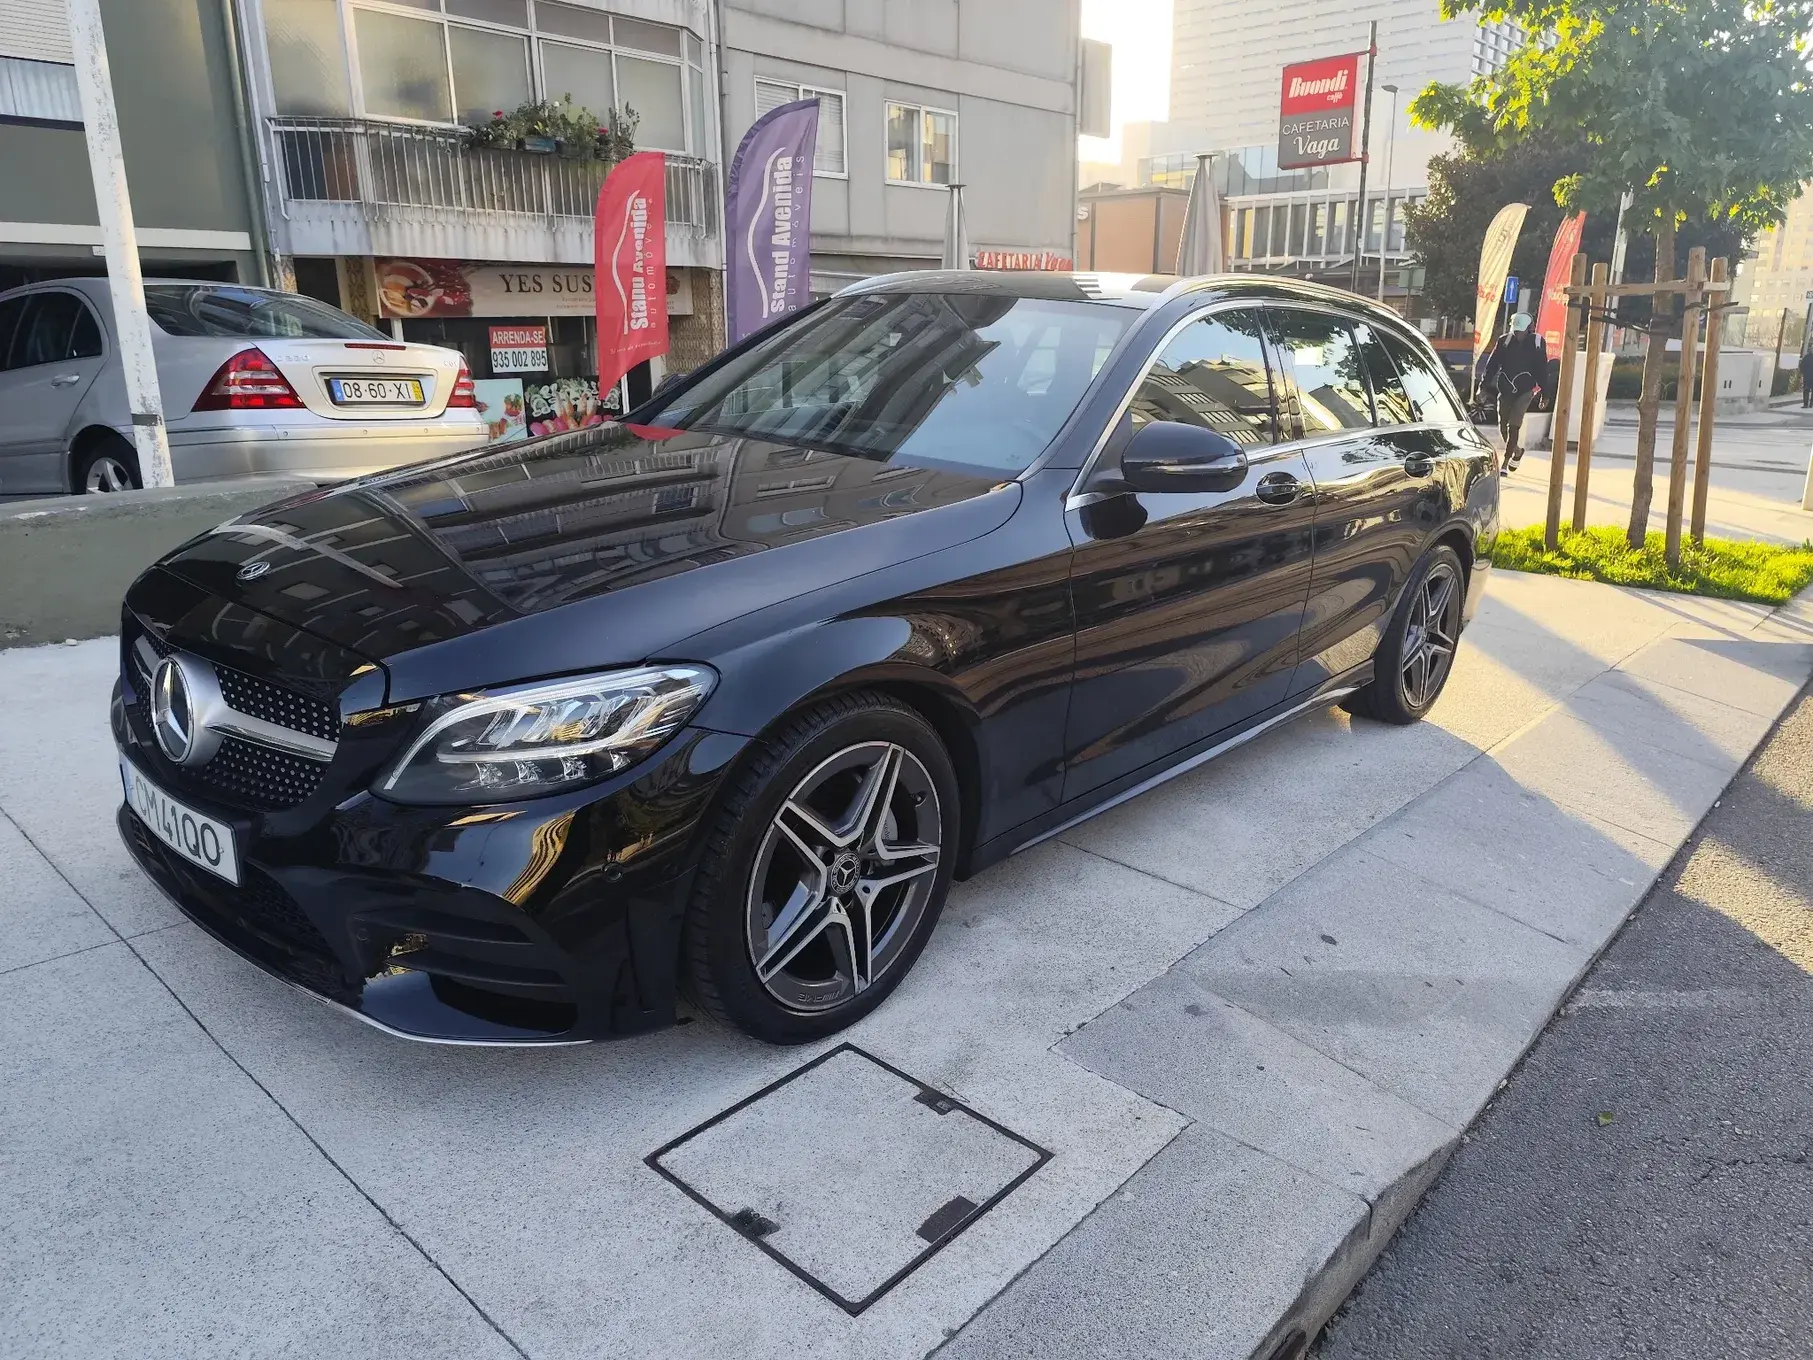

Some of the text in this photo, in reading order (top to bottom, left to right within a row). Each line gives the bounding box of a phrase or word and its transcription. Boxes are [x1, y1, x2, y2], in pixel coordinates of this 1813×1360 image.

[1288, 69, 1349, 98] Buondi
[1282, 116, 1350, 135] CAFETARIA
[1293, 135, 1341, 159] Vaga
[771, 156, 793, 313] Stand Avenida
[499, 274, 543, 293] YES
[492, 350, 547, 368] 935 002 895
